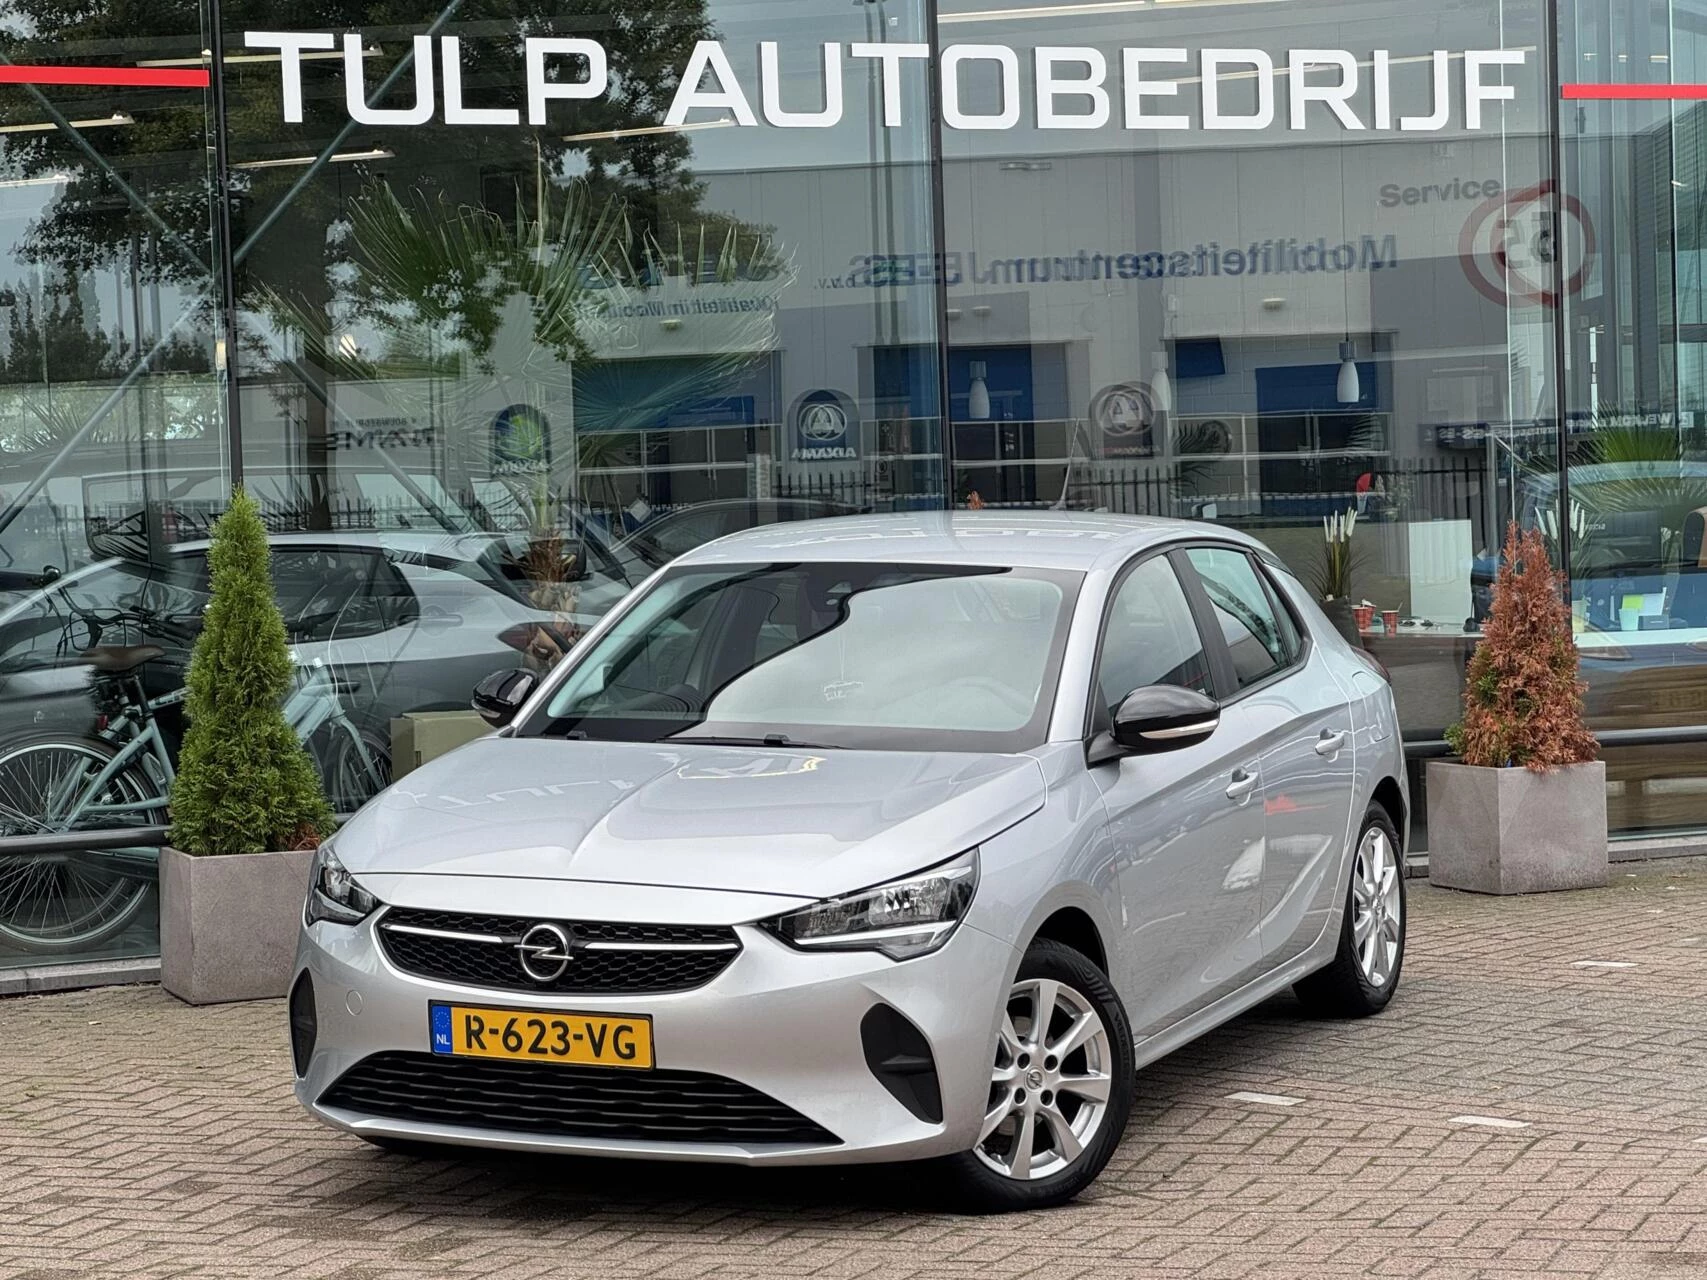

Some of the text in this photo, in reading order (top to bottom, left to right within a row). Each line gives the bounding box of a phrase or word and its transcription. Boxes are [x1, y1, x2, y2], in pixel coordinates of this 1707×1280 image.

[244, 31, 1526, 131] TULP AUTOBEDRIJF
[1379, 177, 1501, 207] Service
[436, 1034, 450, 1046] NL
[464, 1014, 636, 1060] R-623-VG
